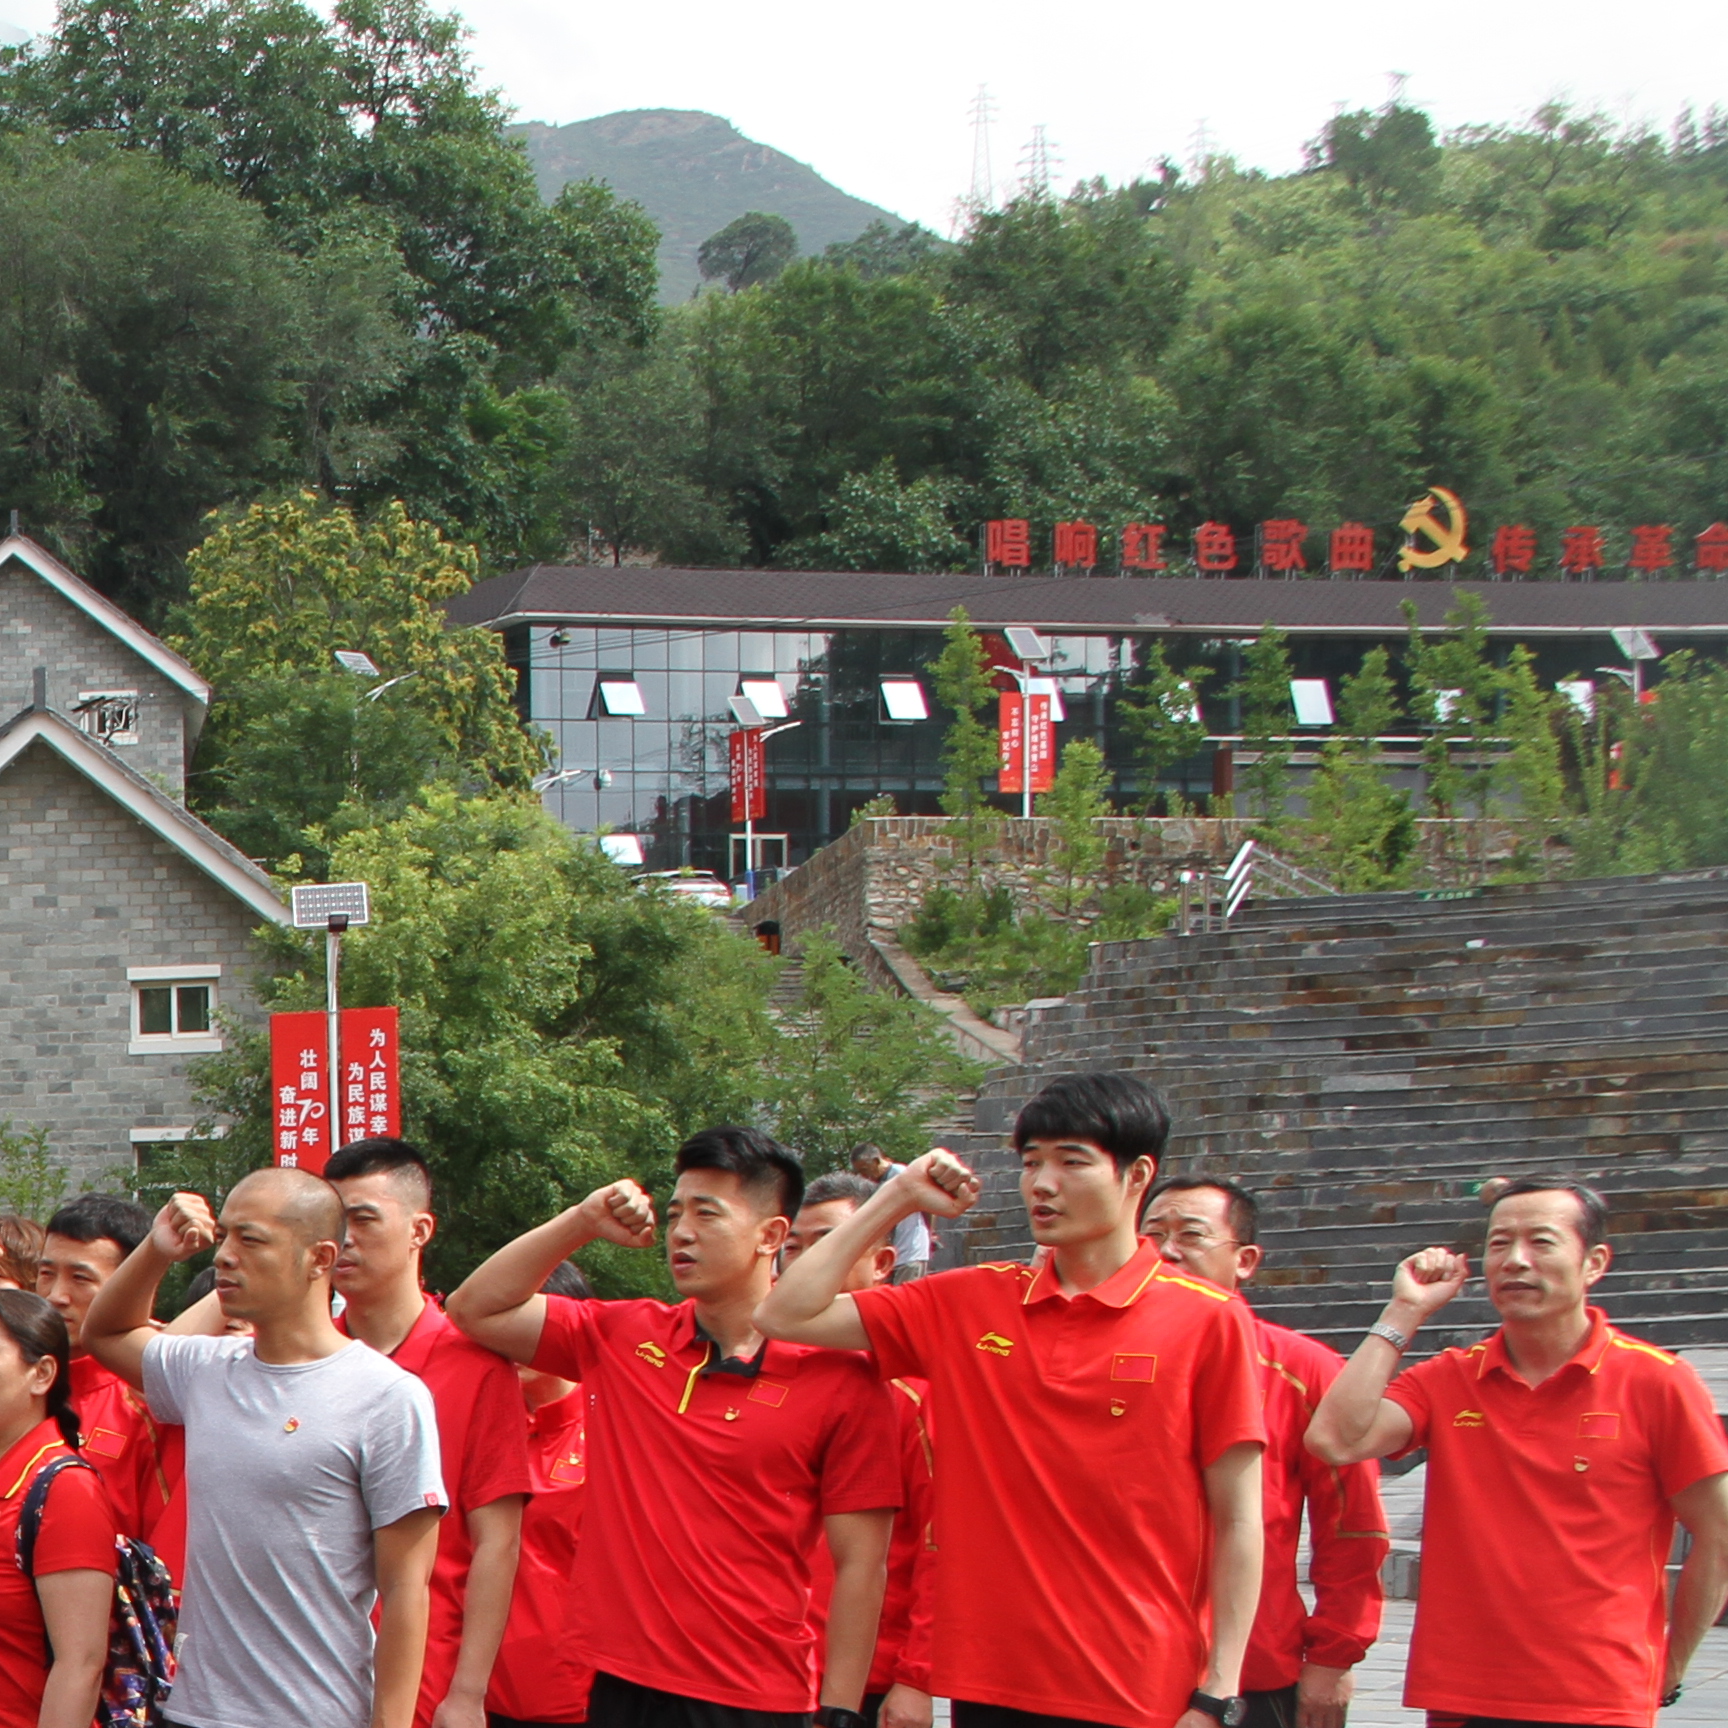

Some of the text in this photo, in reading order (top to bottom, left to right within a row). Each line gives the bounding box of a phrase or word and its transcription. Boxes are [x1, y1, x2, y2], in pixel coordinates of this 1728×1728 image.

[985, 518, 1375, 572] 唱响红色歌曲
[369, 1027, 388, 1135] 为人民谋幸
